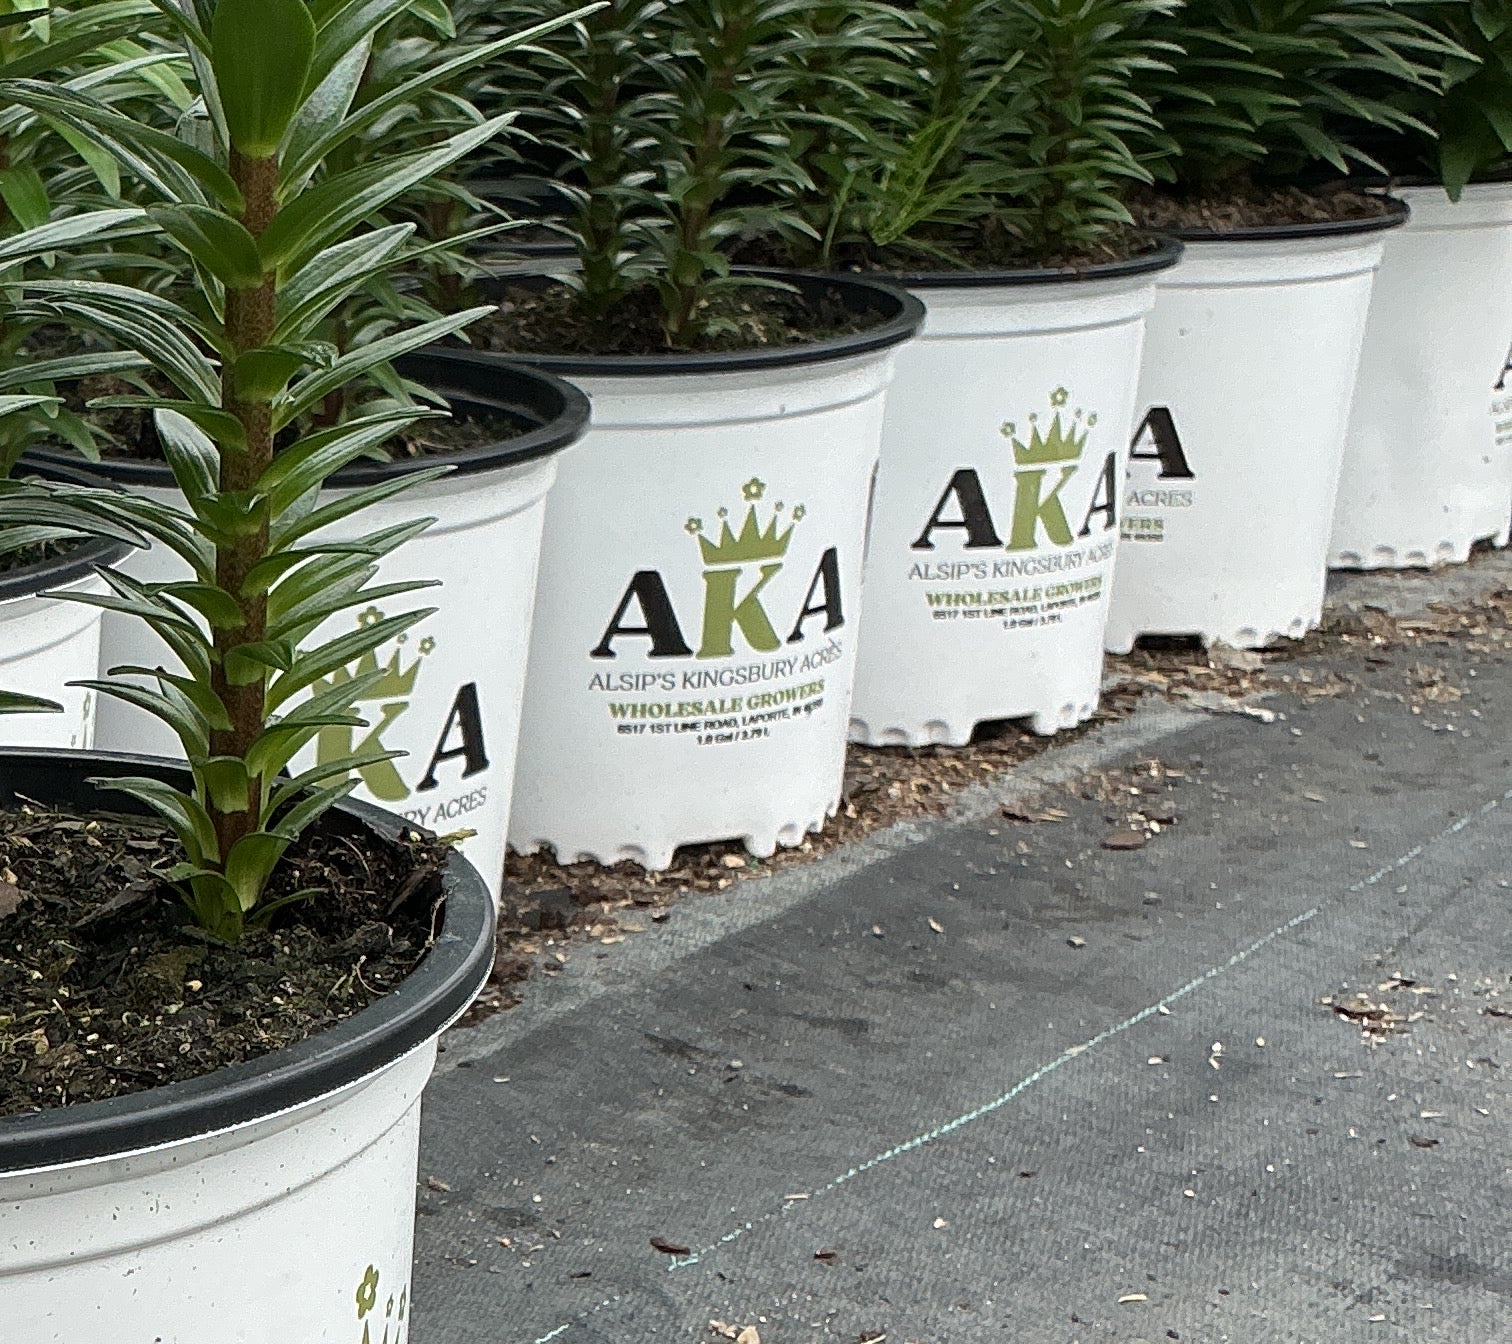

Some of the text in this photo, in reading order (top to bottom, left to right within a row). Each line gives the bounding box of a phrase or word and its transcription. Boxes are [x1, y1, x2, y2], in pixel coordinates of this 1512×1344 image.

[910, 451, 1117, 551] AKA
[909, 561, 988, 581] ALSIP'S
[589, 546, 845, 660] AKA
[588, 671, 676, 693] ALSIP'S
[681, 655, 799, 691] KINGSBURY
[608, 696, 743, 720] WHOLESALE
[746, 679, 825, 710] GROWERS
